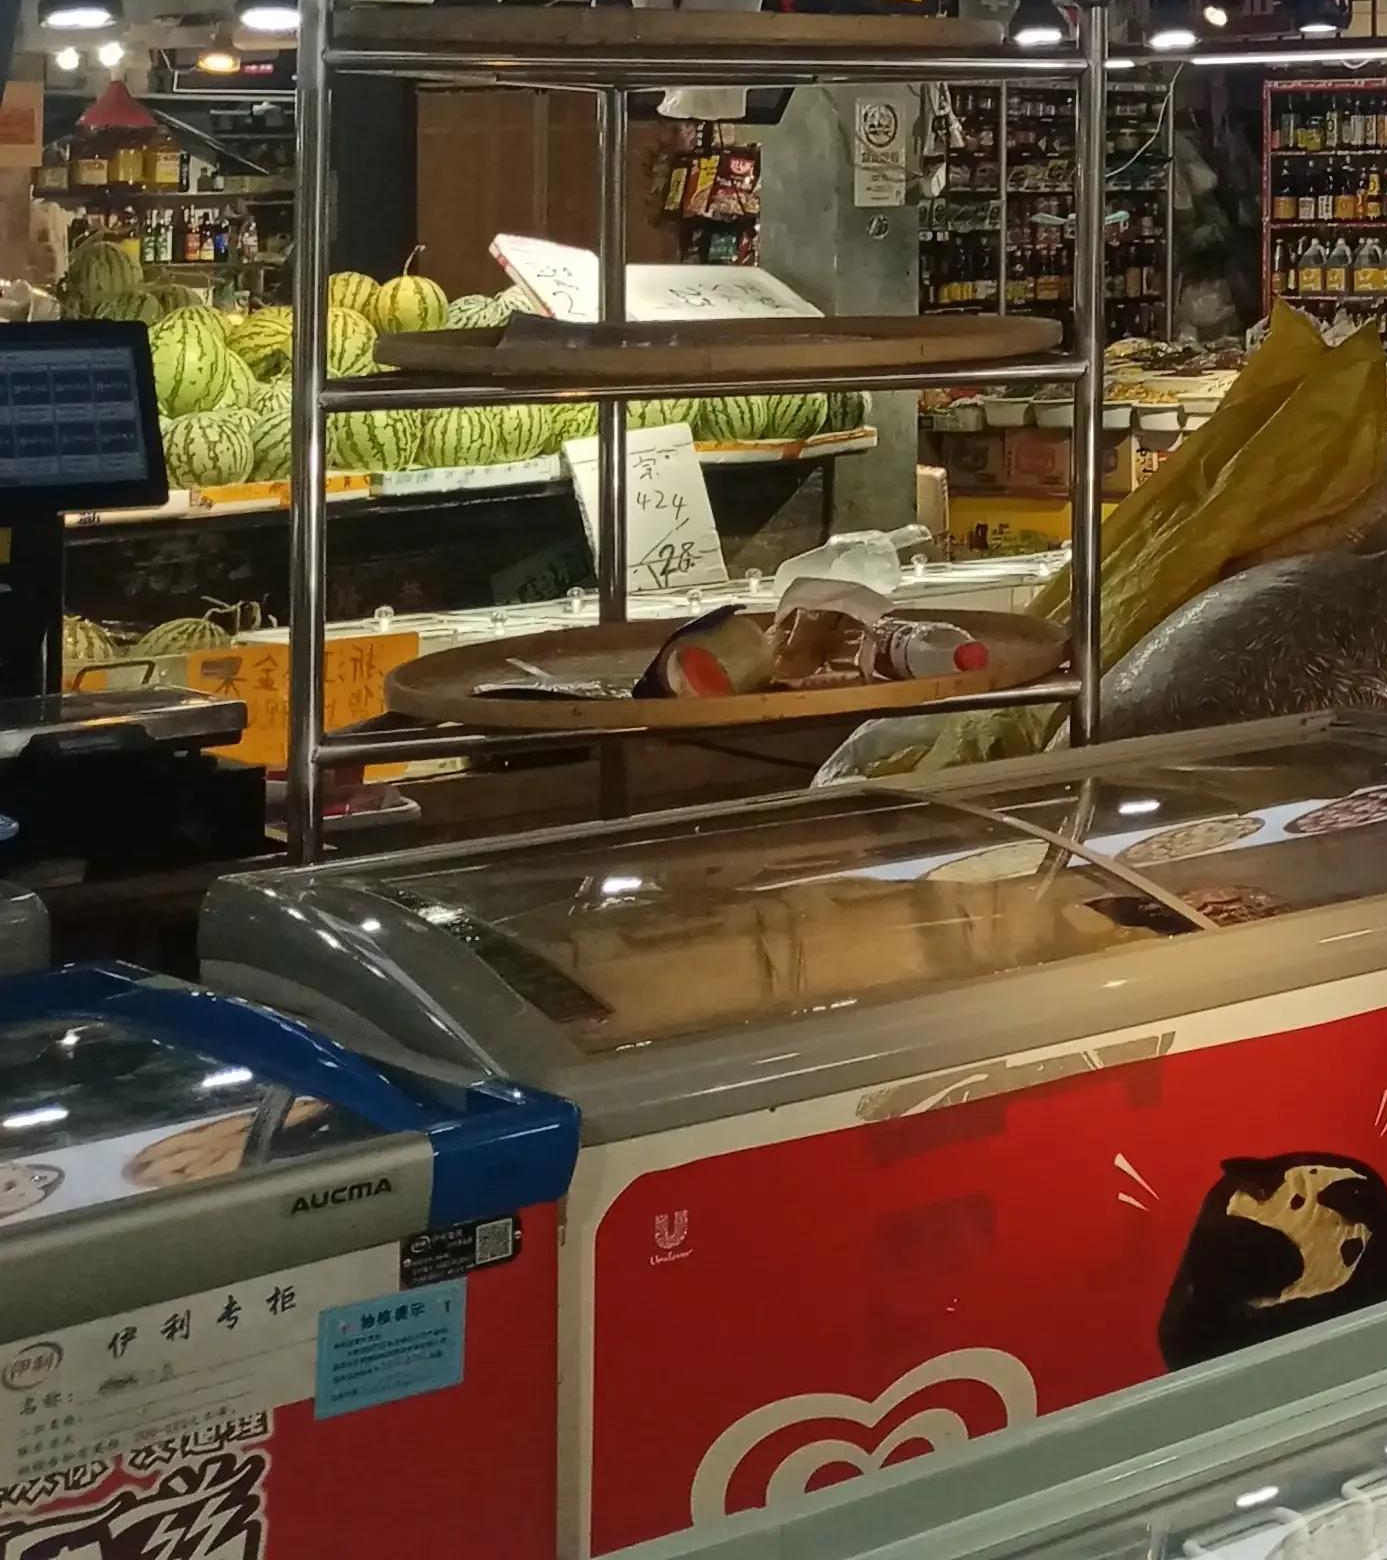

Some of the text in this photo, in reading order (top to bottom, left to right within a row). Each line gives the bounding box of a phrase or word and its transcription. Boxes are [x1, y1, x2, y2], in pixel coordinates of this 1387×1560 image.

[290, 1177, 393, 1216] AUCMA
[108, 1285, 297, 1358] 伊利专柜
